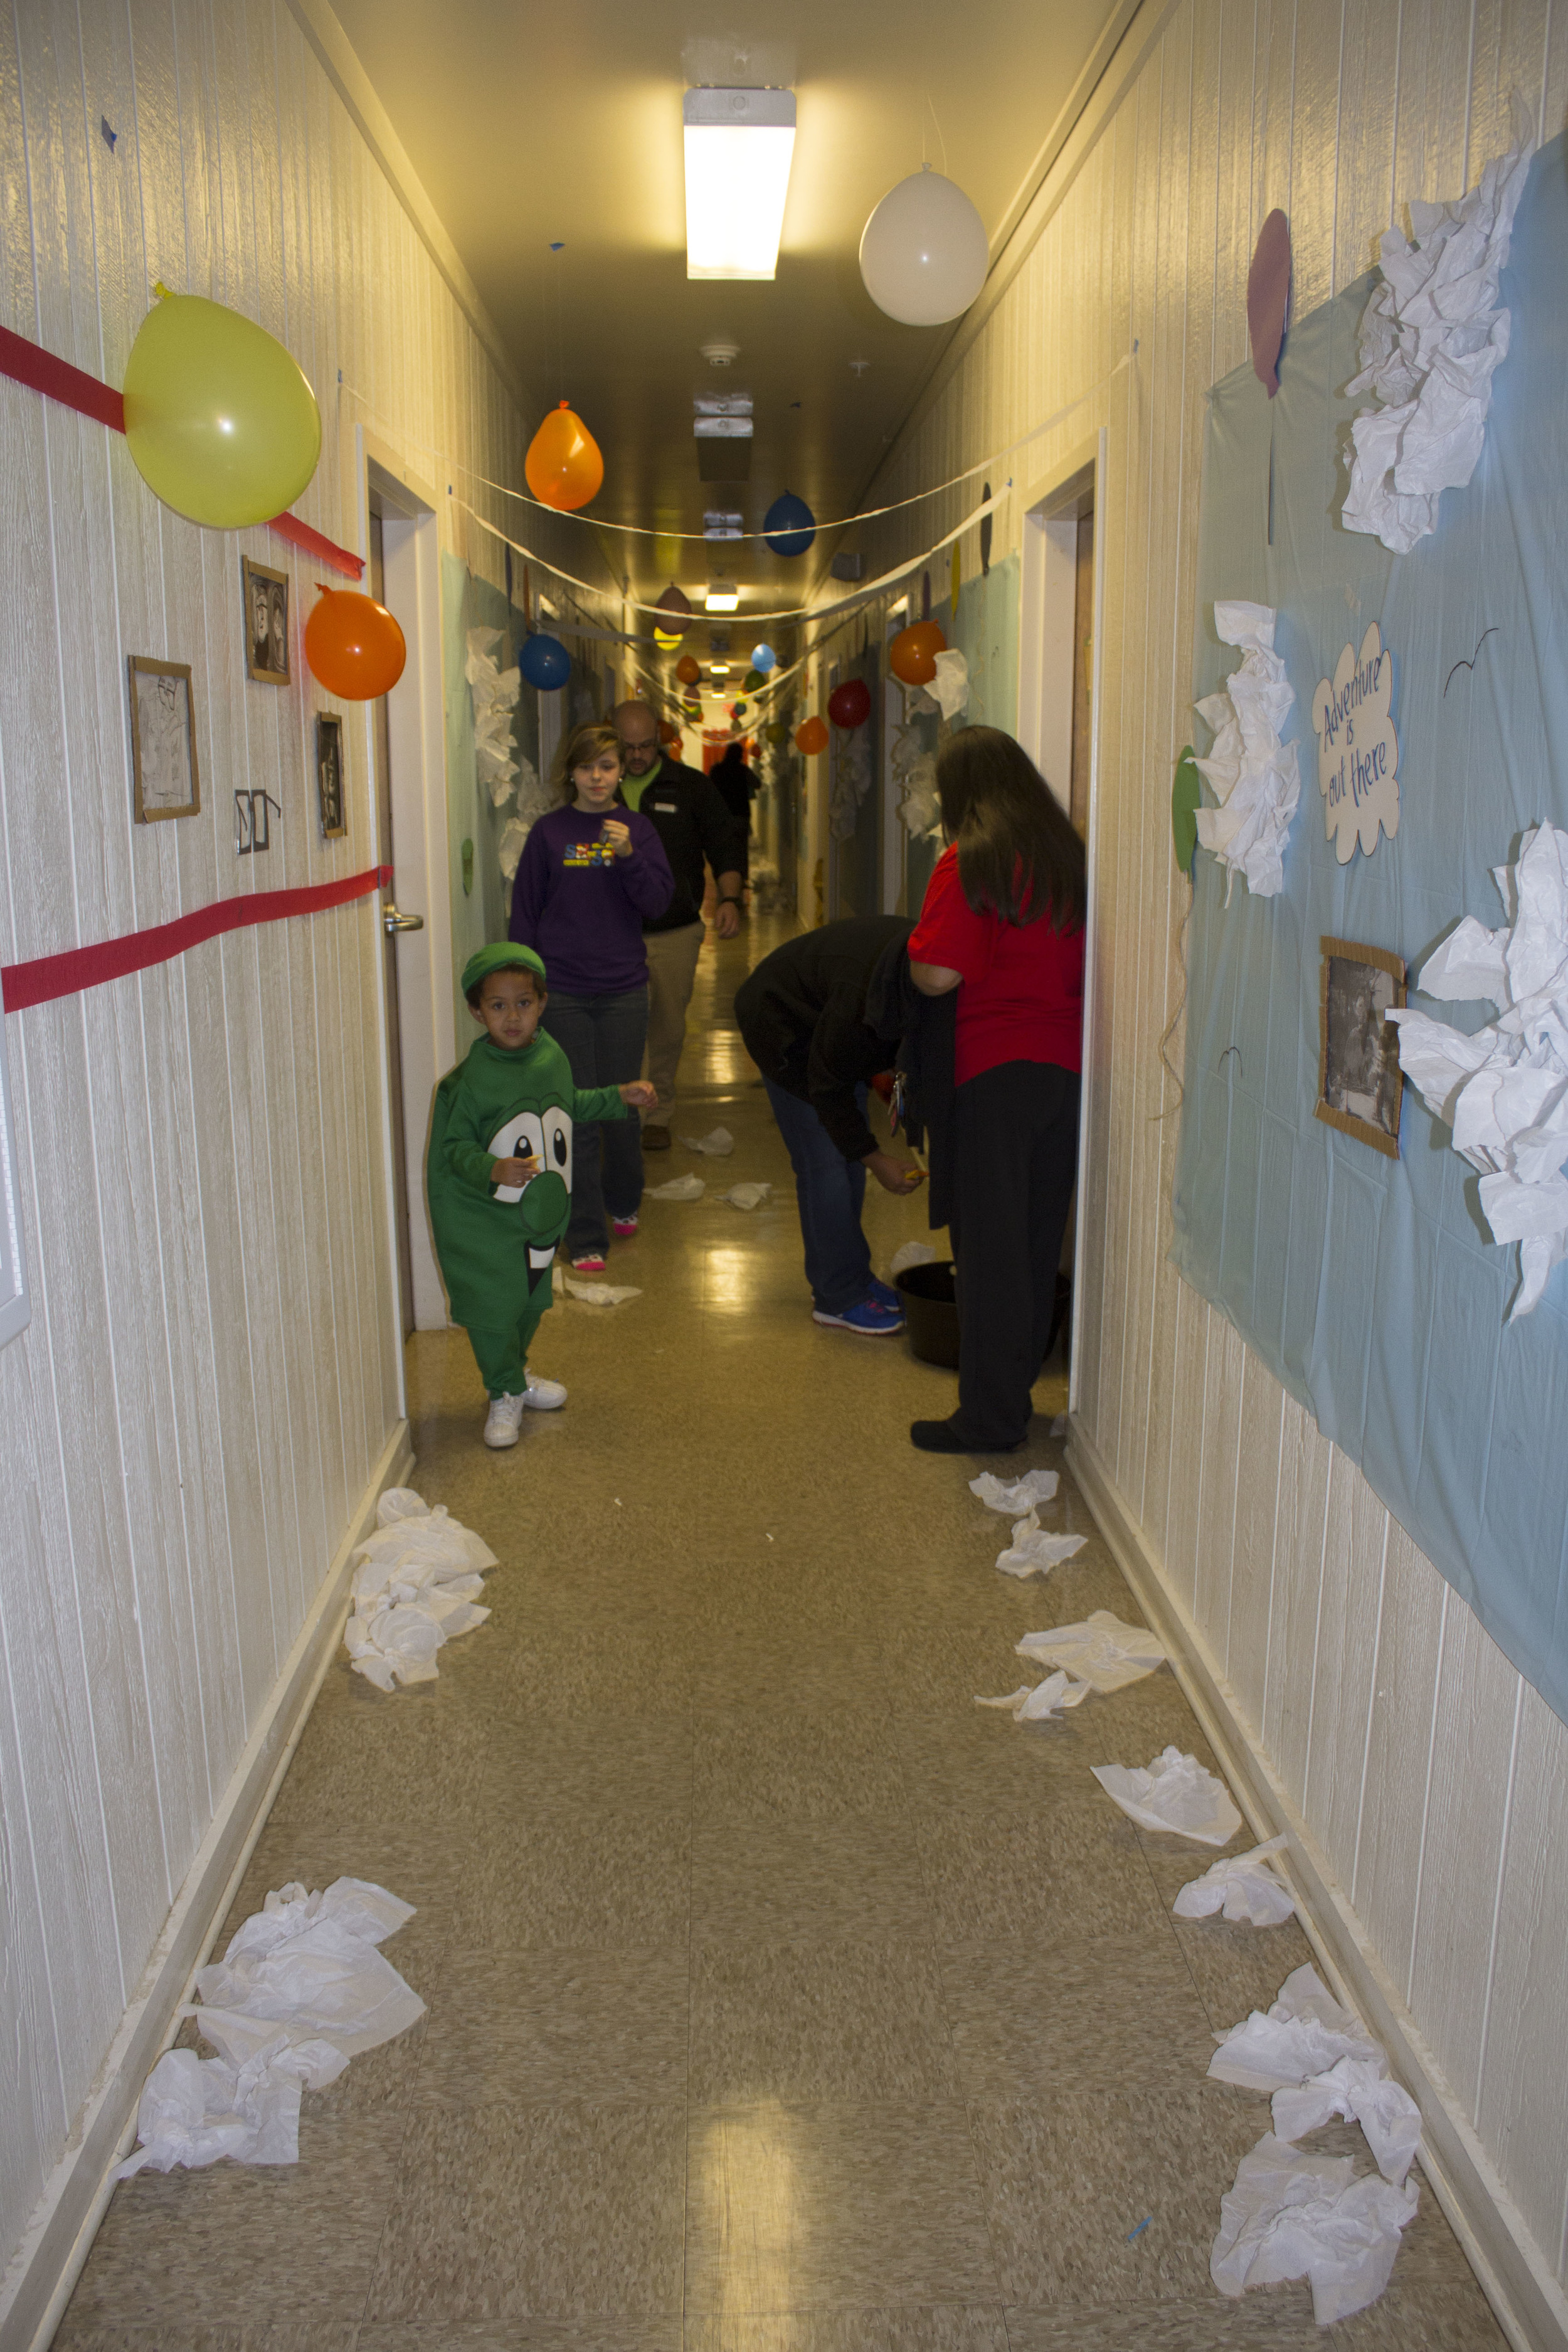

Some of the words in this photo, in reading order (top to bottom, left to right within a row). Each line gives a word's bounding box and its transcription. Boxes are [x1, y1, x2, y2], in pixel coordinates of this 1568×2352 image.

[1324, 657, 1380, 752] Adventure
[1346, 718, 1353, 746] is
[1328, 755, 1346, 807] out
[1350, 741, 1387, 808] there
